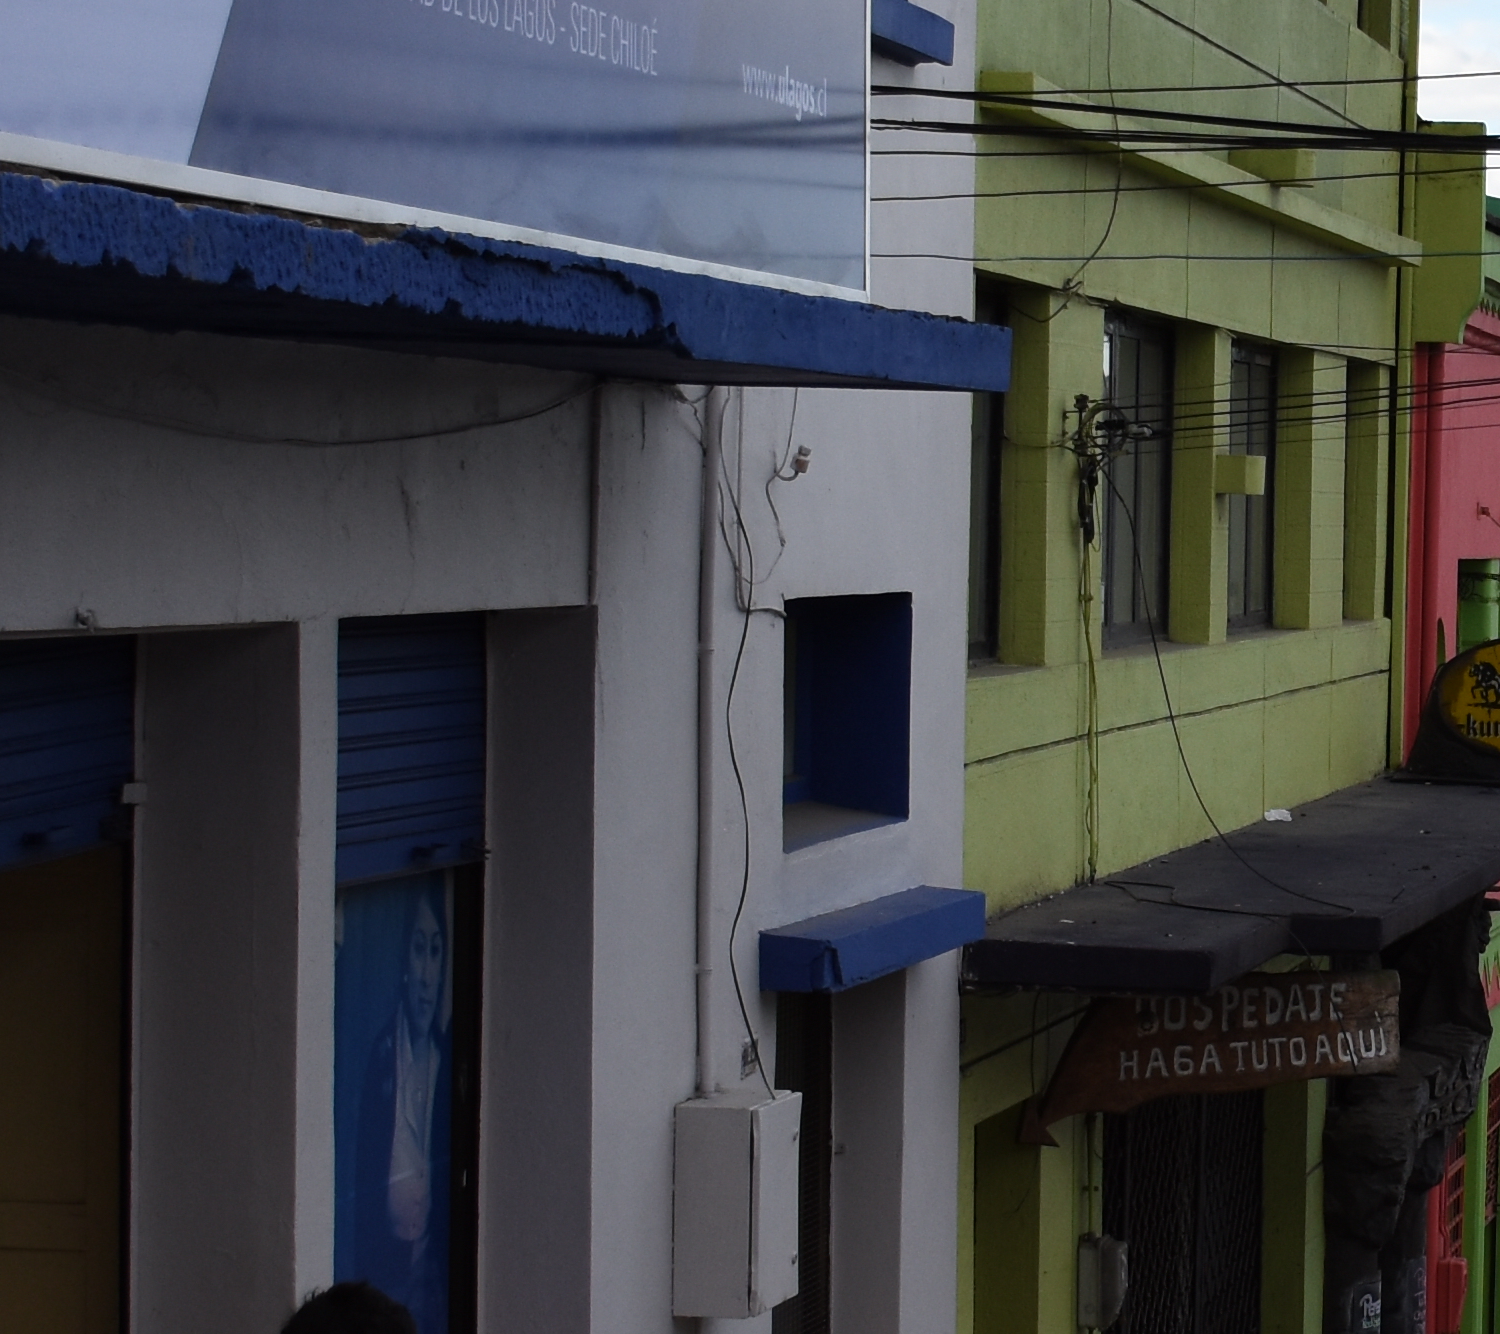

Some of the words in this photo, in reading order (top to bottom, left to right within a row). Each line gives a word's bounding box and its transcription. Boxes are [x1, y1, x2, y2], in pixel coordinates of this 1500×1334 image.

[570, 1, 607, 61] SEDE
[610, 17, 658, 77] CHILOÉ
[741, 62, 828, 122] www.ulagos.cl
[1229, 1036, 1308, 1072] TUTO
